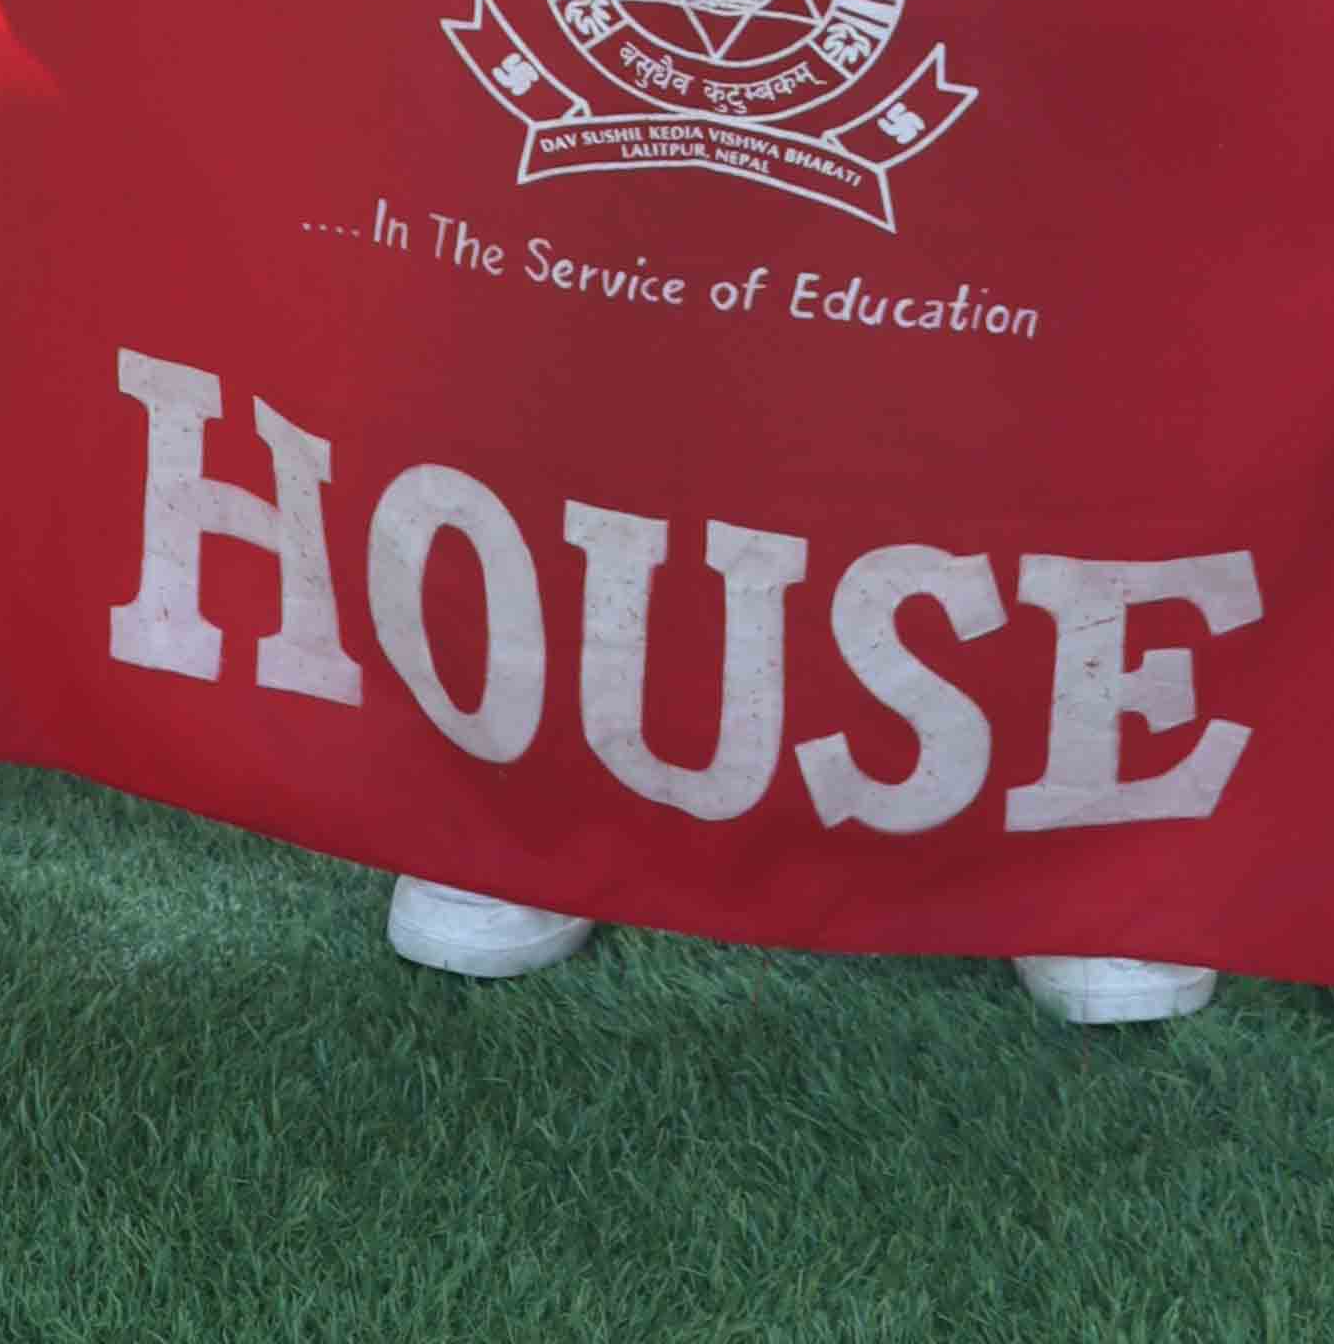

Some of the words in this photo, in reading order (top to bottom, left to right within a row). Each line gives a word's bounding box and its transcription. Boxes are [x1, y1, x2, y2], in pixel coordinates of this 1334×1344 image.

[539, 132, 578, 154] DAV
[580, 126, 643, 145] SUSHIL
[648, 125, 704, 141] KEDIA
[708, 127, 780, 159] VISHWA
[783, 147, 863, 187] BHARATI
[715, 148, 772, 173] NEPAL
[428, 212, 505, 277] The
[523, 236, 686, 306] Service
[709, 265, 770, 312] of
[788, 271, 1039, 338] Education
[109, 347, 1264, 833] HOUSE
